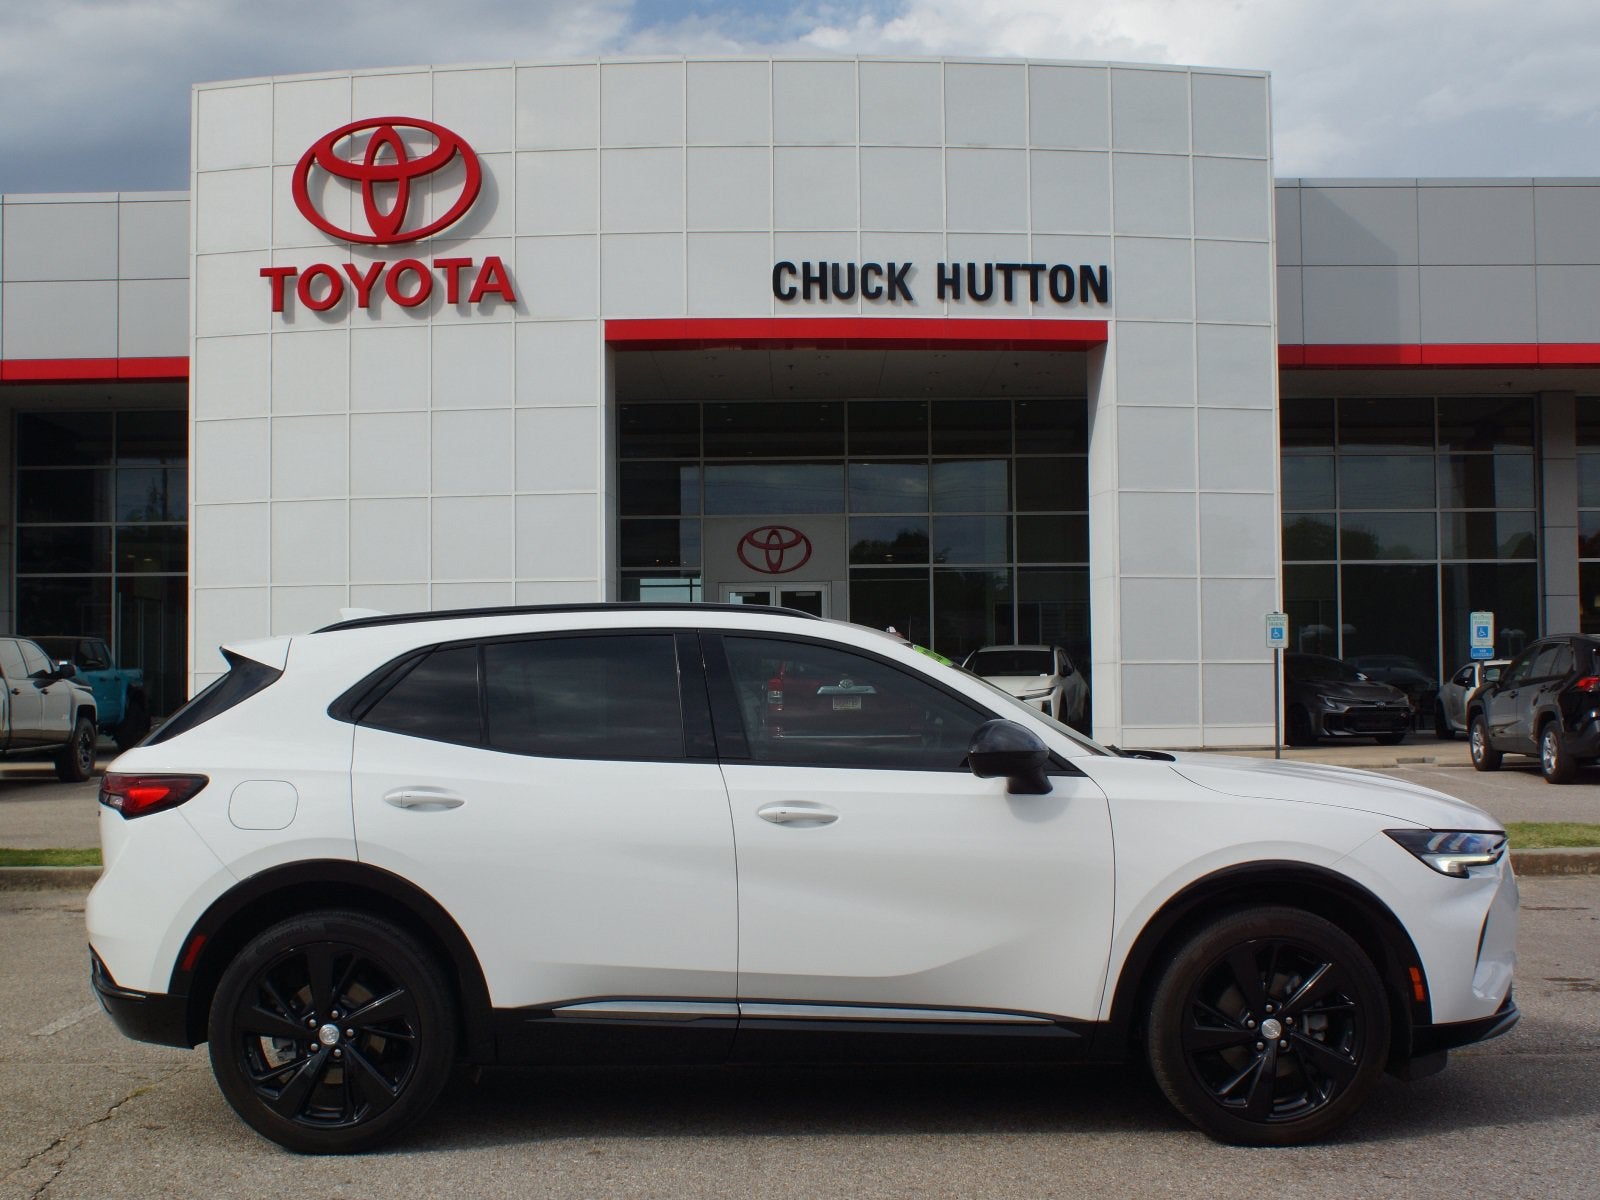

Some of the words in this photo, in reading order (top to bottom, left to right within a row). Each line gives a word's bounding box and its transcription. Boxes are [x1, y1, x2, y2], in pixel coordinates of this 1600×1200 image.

[259, 256, 517, 312] TOYOTA
[772, 261, 914, 300] CHUCK
[937, 262, 1108, 303] HUTTON
